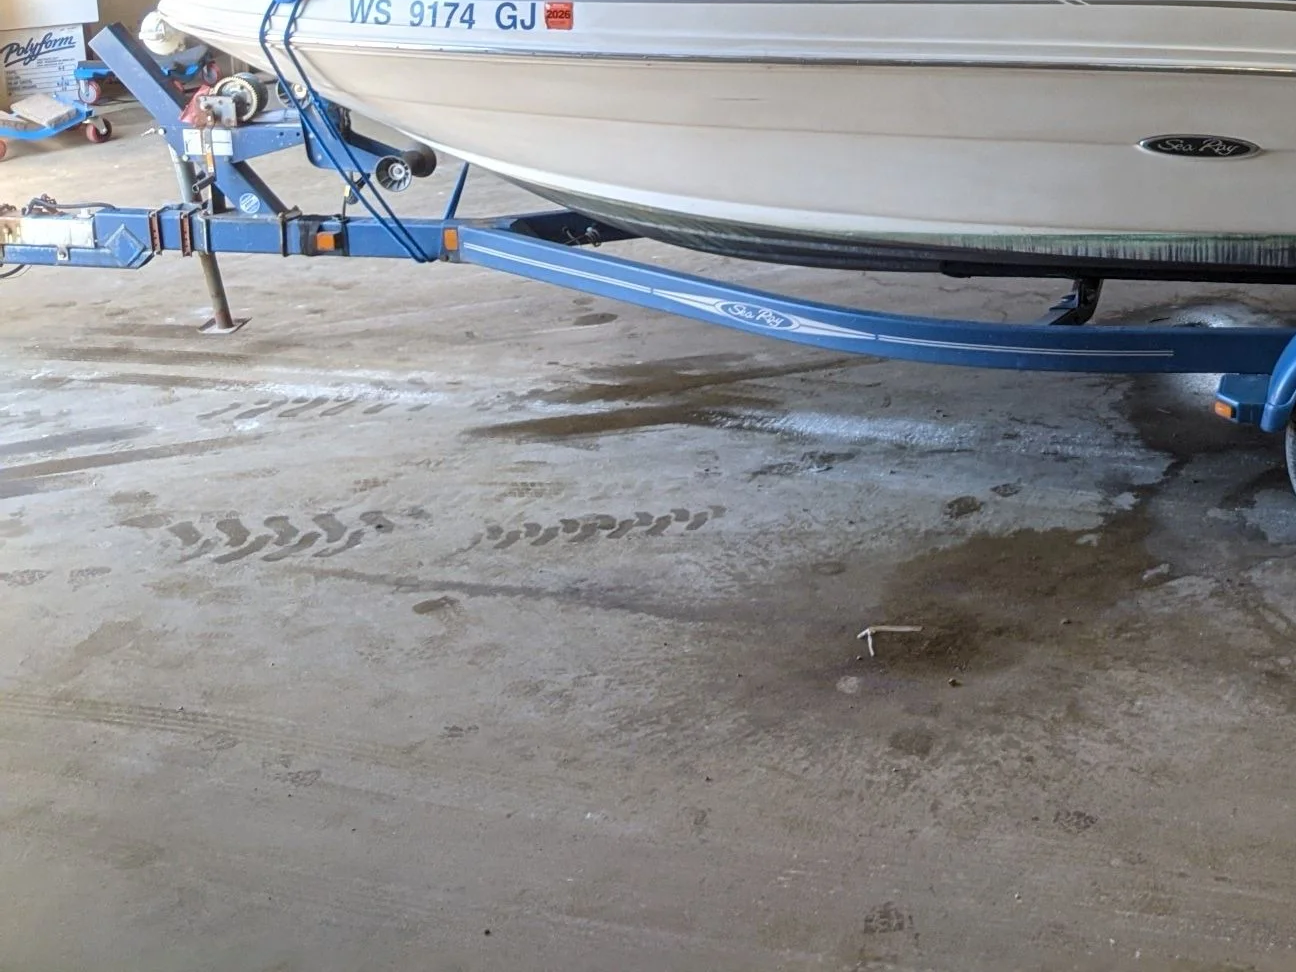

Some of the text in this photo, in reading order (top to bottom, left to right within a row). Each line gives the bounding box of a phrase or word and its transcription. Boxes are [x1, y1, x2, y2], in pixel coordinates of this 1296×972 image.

[409, 0, 476, 29] 9174
[495, 2, 537, 31] GJ
[547, 9, 571, 19] 2026
[0, 32, 76, 66] Polyform
[1158, 138, 1239, 156] Sea Ray
[728, 304, 784, 328] Sea Ray
